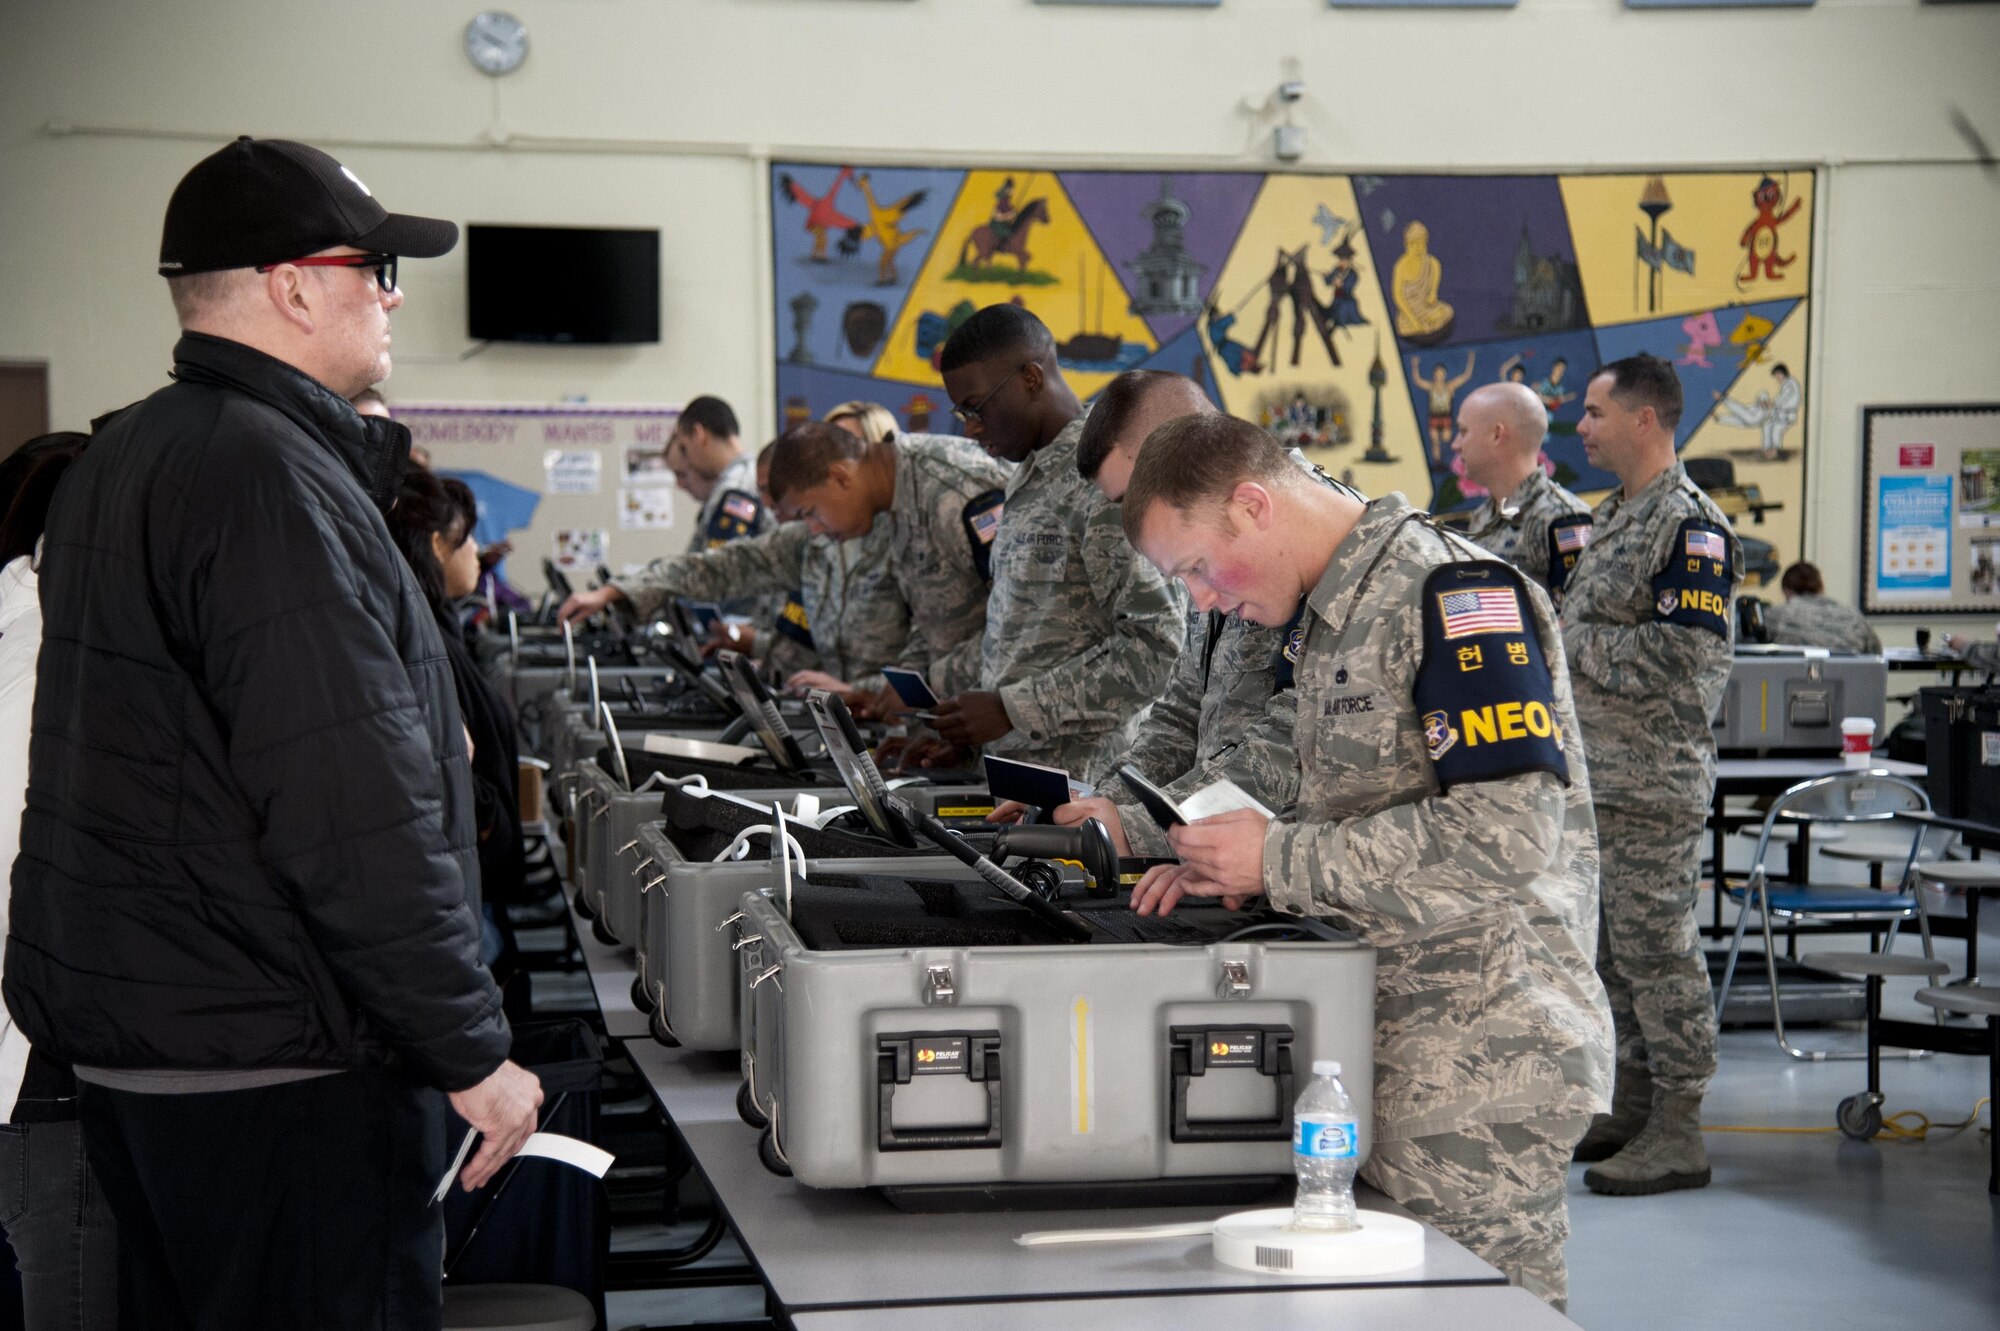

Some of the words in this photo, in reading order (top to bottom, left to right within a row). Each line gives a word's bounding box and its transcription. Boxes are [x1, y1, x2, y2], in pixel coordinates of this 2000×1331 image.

[1681, 588, 1723, 616] NEO
[1341, 695, 1375, 716] FORCE
[1461, 701, 1551, 747] NEO
